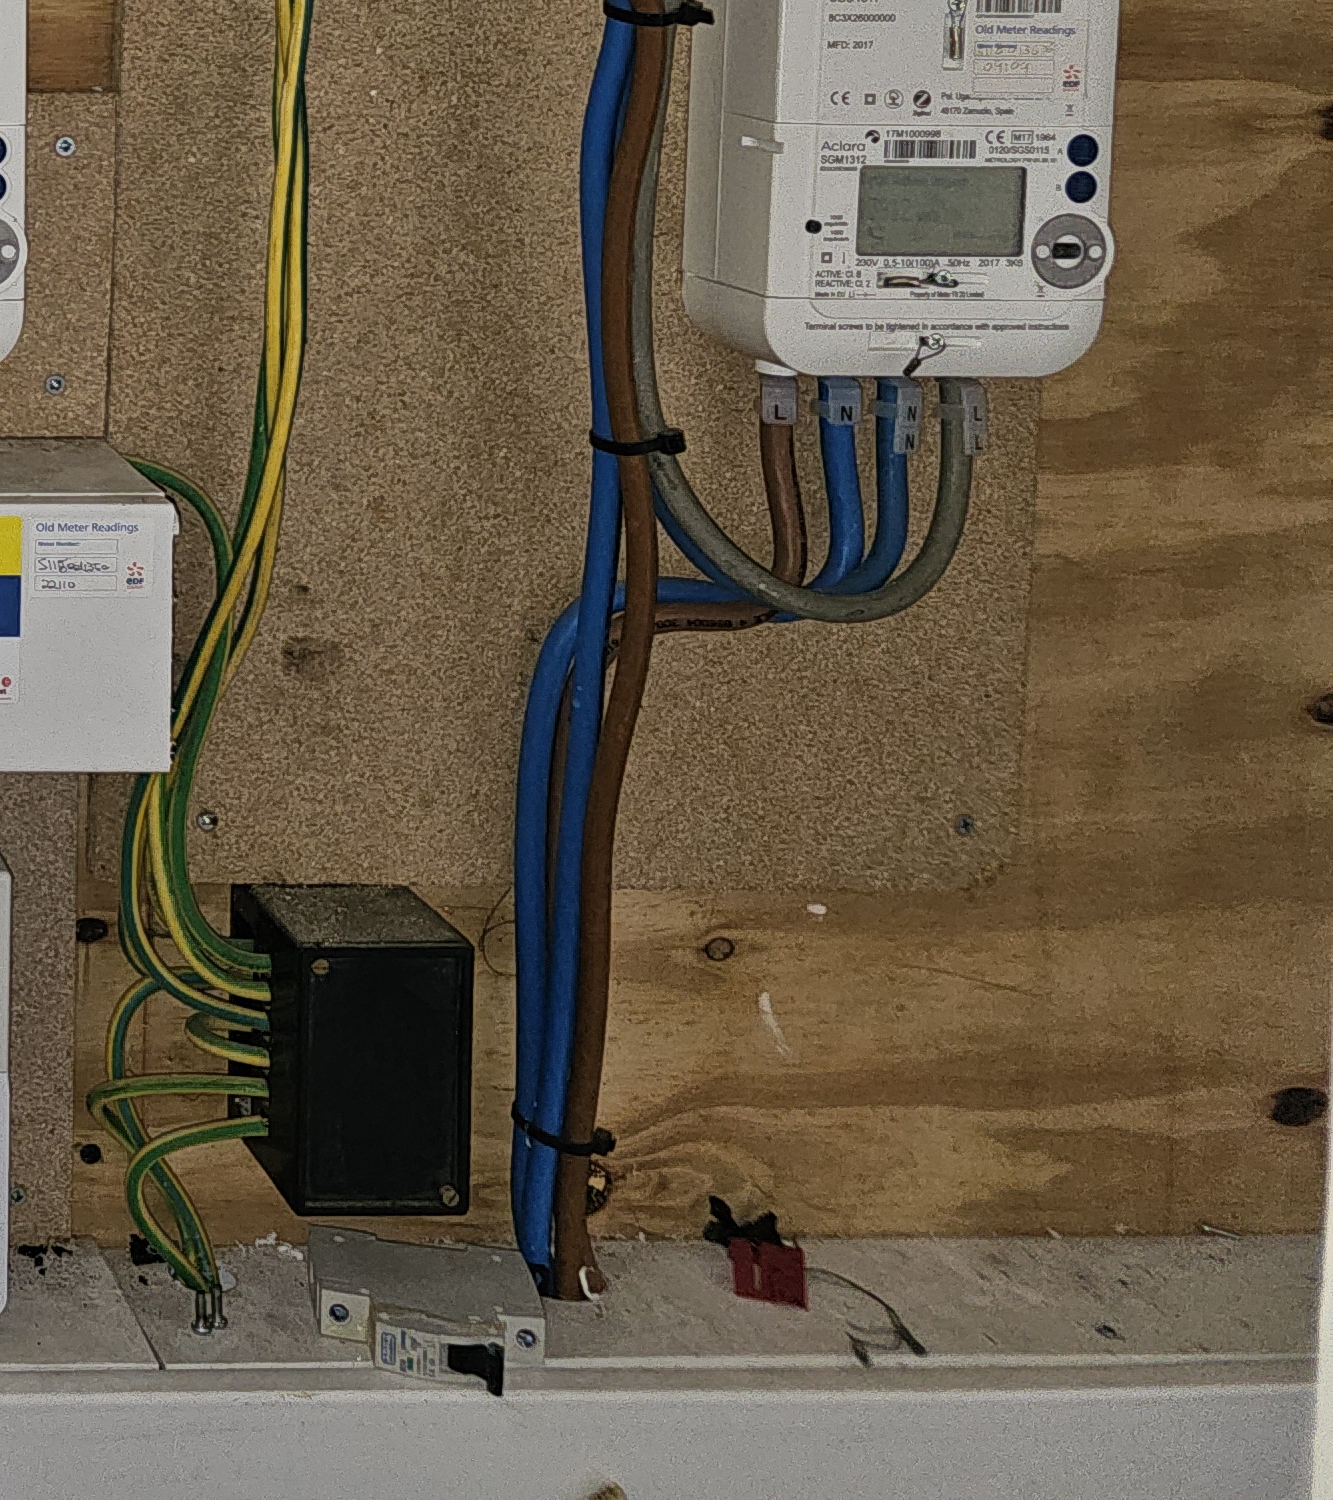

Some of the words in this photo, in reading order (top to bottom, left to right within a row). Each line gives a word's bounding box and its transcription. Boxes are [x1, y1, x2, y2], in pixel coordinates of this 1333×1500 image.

[975, 24, 994, 36] Old
[996, 24, 1027, 36] Meter
[1029, 24, 1076, 38] Readings
[36, 522, 55, 533] Old
[57, 523, 89, 533] Meter
[92, 522, 139, 535] Readings
